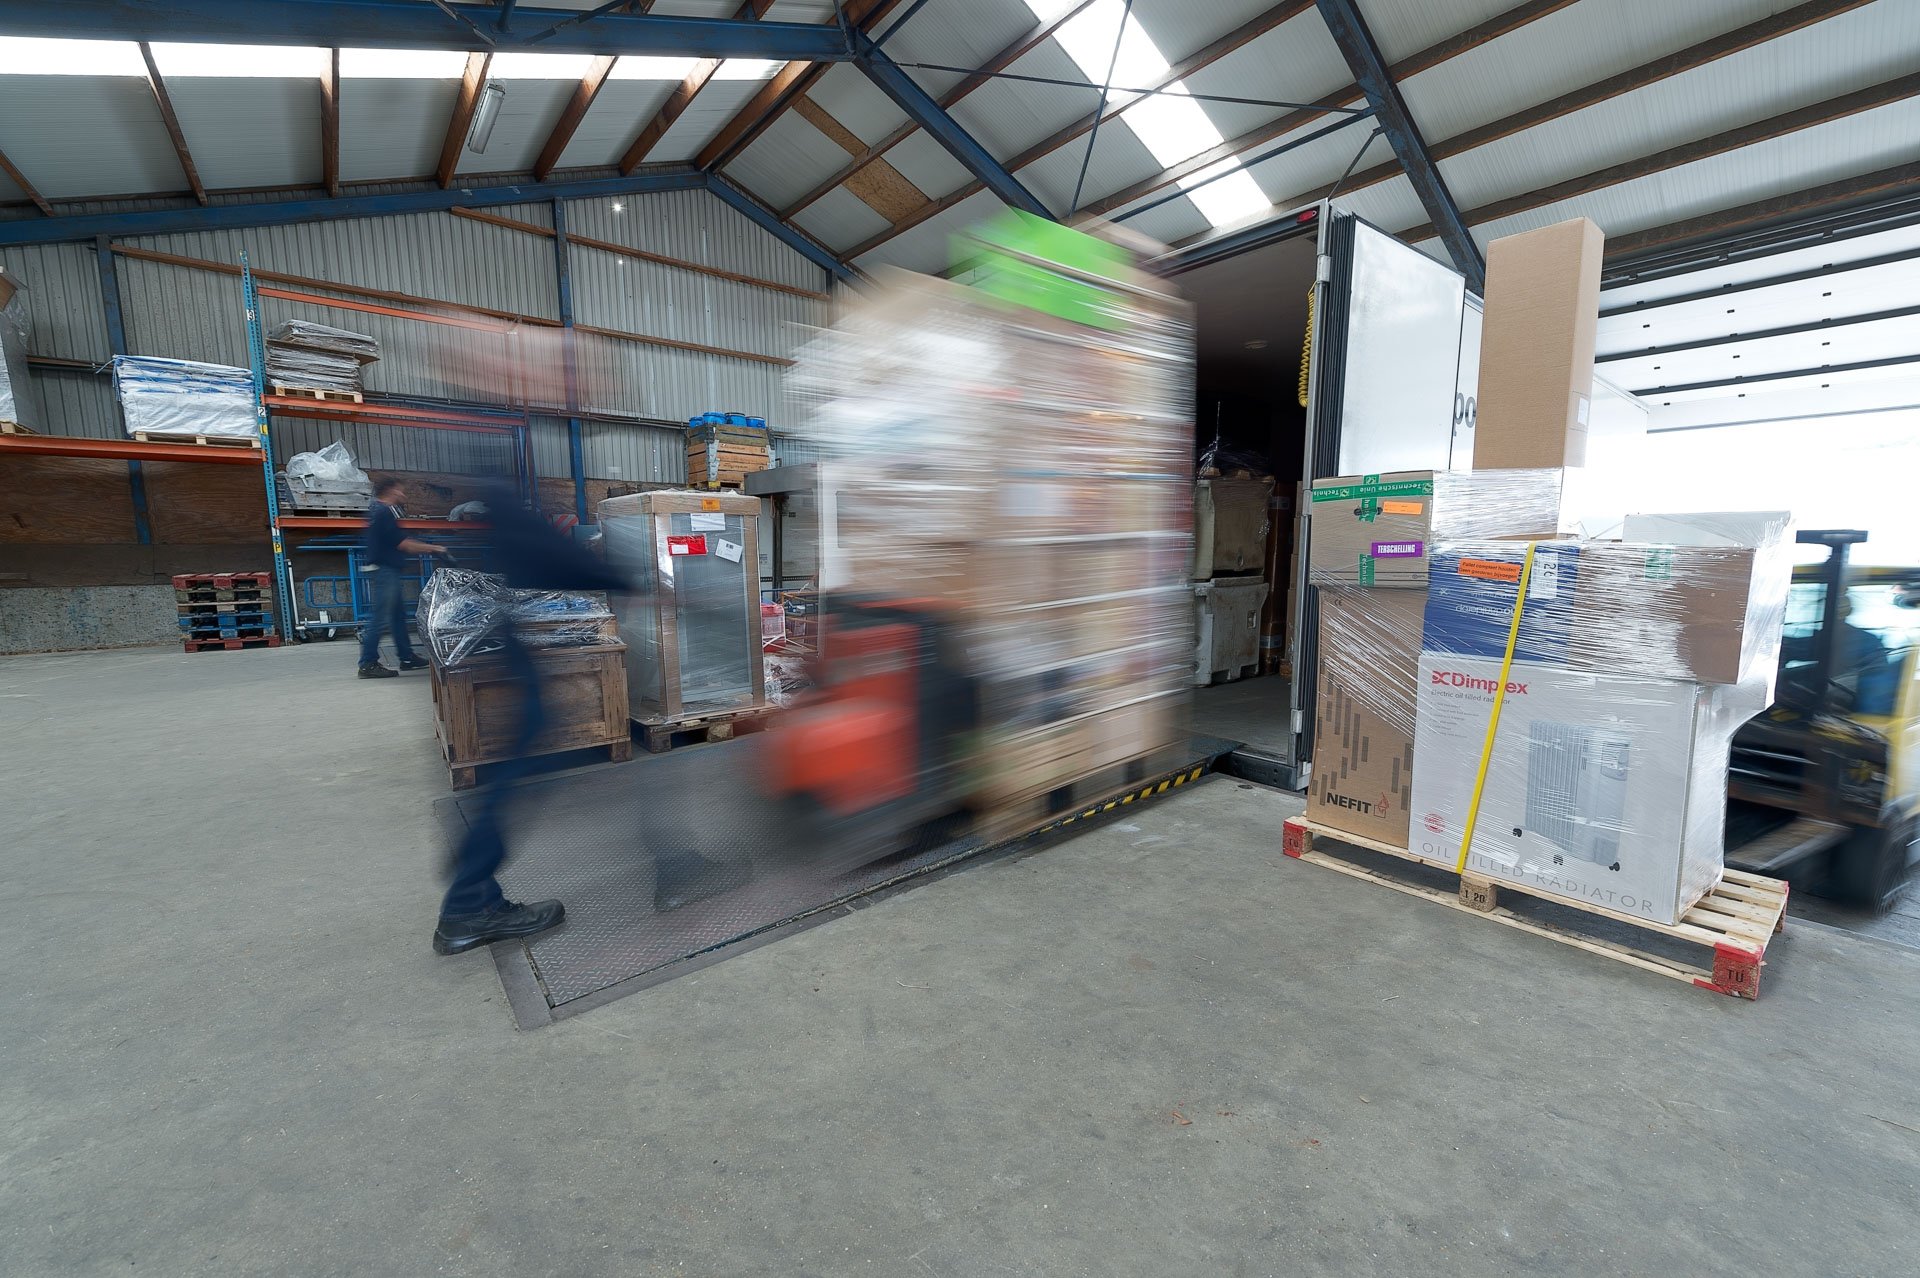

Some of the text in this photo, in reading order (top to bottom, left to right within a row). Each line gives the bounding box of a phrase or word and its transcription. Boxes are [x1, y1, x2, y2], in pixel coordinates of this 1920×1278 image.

[259, 407, 265, 417] 2
[1378, 483, 1422, 491] Technische
[1377, 544, 1416, 554] TERSCHELLING
[1452, 672, 1528, 694] Dimpex
[1431, 690, 1454, 698] Electric
[1483, 696, 1511, 705] rador
[1327, 792, 1371, 814] NEFIT
[1422, 842, 1654, 913] OIL ILLED RADIATOR
